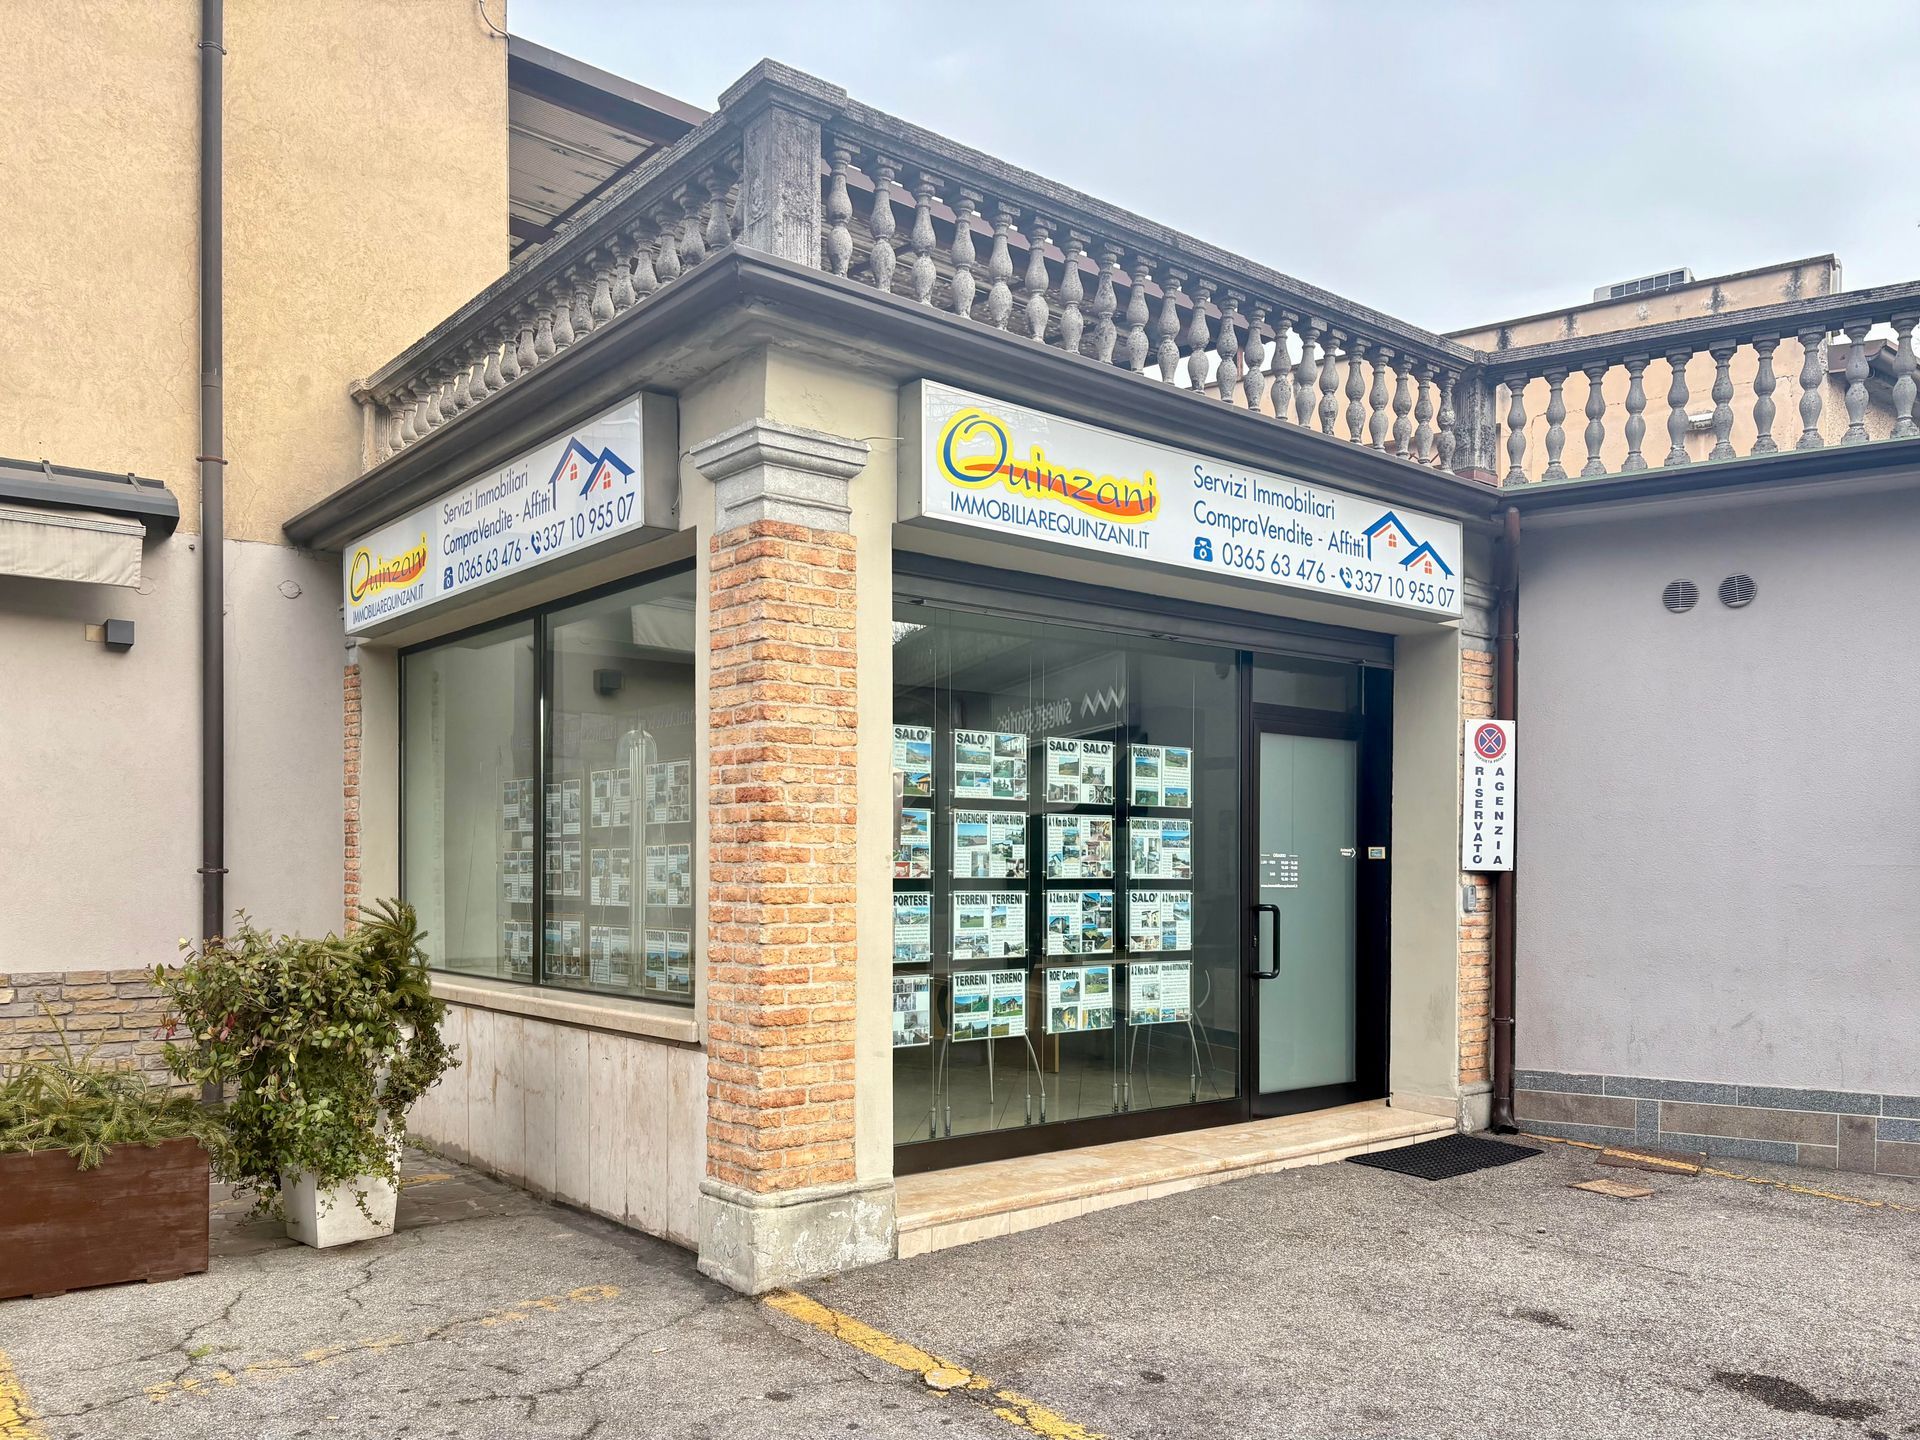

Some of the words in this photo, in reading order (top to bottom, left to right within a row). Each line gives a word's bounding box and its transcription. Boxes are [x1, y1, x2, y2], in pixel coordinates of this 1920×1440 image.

[941, 411, 1157, 515] Quinzani
[1193, 464, 1248, 501] Servizi
[1252, 478, 1336, 521] Immobiliari
[443, 498, 473, 525] Servizi
[475, 464, 528, 511] Immobiliari
[443, 508, 513, 556] CompraVendite
[522, 489, 551, 523] Affitti
[949, 490, 1151, 551] IMMOBILIAREQUINZANI.IT
[457, 556, 483, 585] 0365
[485, 552, 499, 573] 63
[501, 540, 522, 568] 476
[542, 520, 566, 551] 337
[570, 512, 585, 542] 10
[588, 501, 614, 534] 955
[617, 491, 636, 522] 07
[1193, 500, 1314, 549] CompraVendite
[1328, 531, 1366, 559] Affitti
[350, 536, 428, 602] Quinzani
[1221, 542, 1266, 574] 0365
[1270, 550, 1293, 578] 63
[1296, 555, 1326, 584] 476
[1354, 566, 1383, 594] 337
[1387, 572, 1405, 599] 10
[1408, 576, 1436, 604] 955
[1438, 581, 1455, 609] 07
[352, 583, 425, 625] IMMOBILIAREQUINZANI.IT
[1132, 746, 1161, 759] PUEGNAGO
[955, 812, 989, 825] PADENGHE
[1472, 766, 1485, 865] RISERVATO
[1492, 766, 1505, 865] AGENZIA
[893, 894, 929, 907] PORTESE
[955, 894, 988, 906] TERRENI
[991, 893, 1023, 905] TERRENI
[954, 975, 987, 987] TERRENI
[991, 972, 1023, 985] TERRENO
